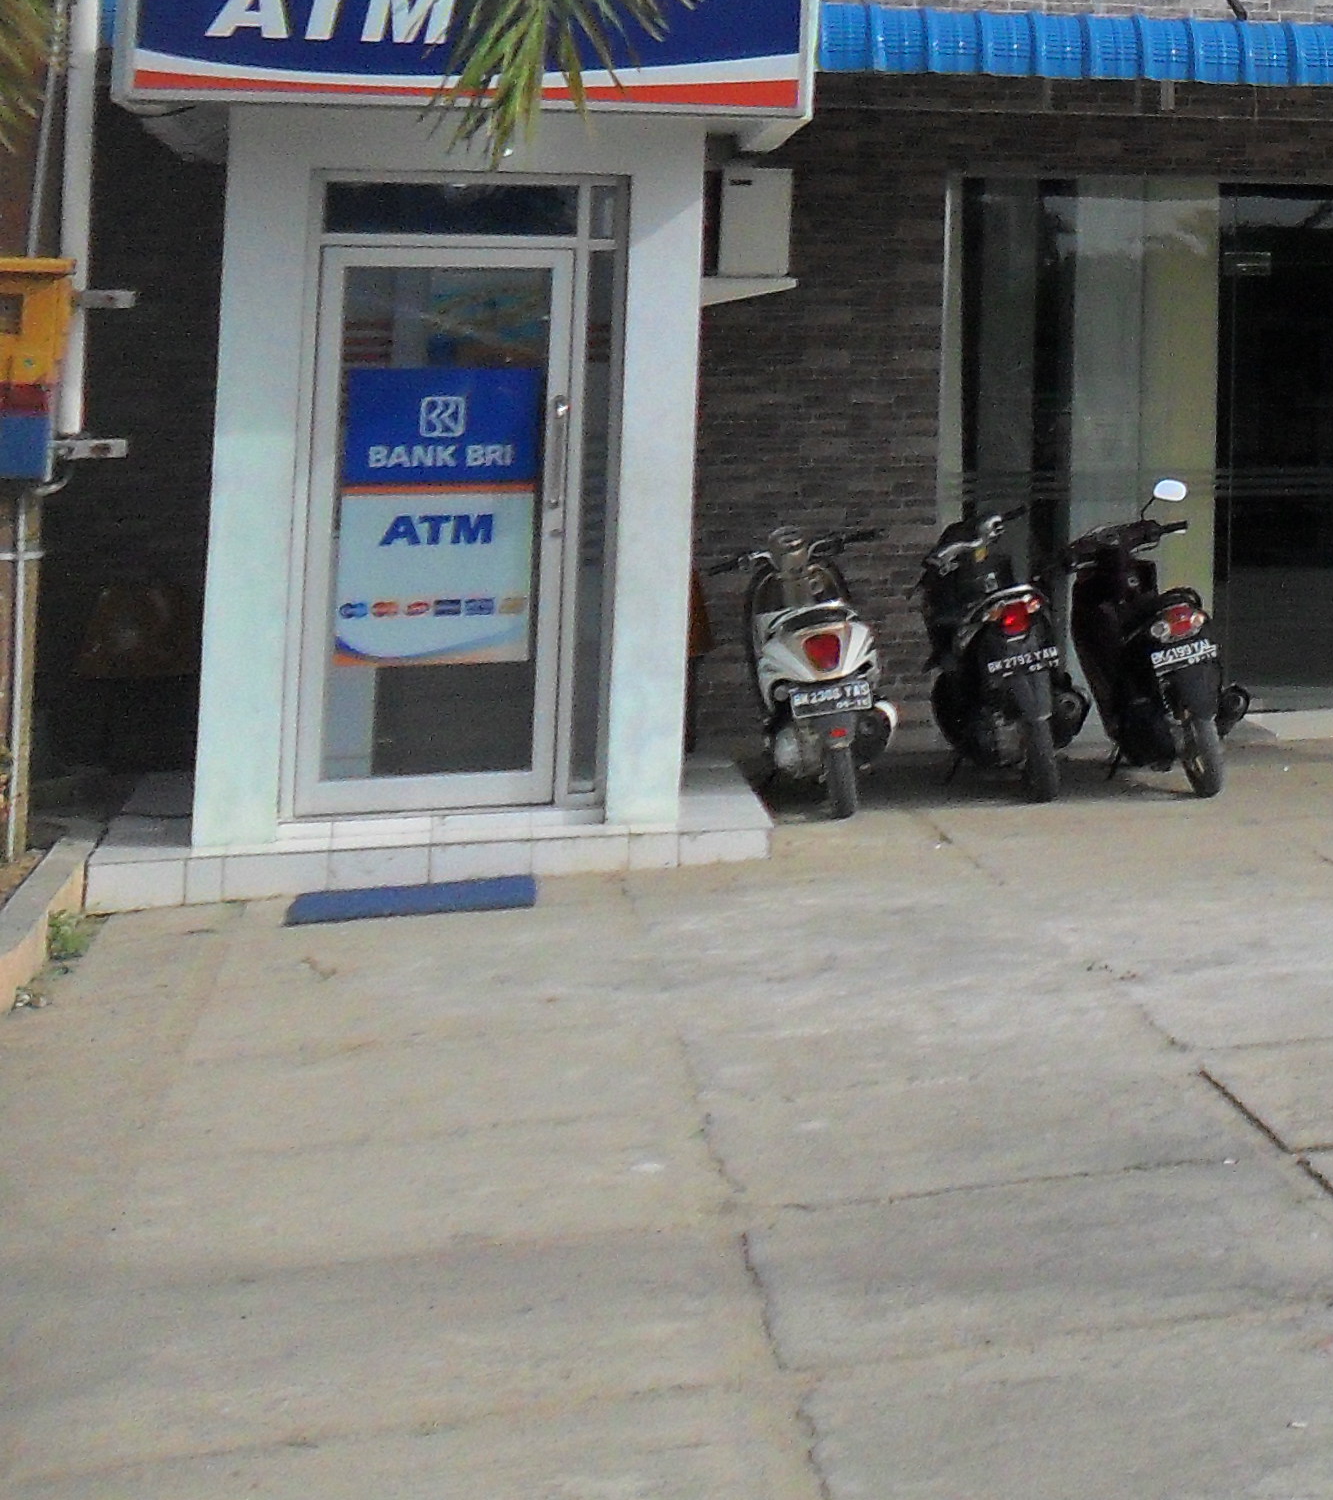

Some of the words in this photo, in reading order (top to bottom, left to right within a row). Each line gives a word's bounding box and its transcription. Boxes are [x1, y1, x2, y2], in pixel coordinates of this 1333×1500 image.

[368, 445, 457, 469] BANK
[465, 444, 514, 468] BRI
[378, 514, 494, 546] ATM
